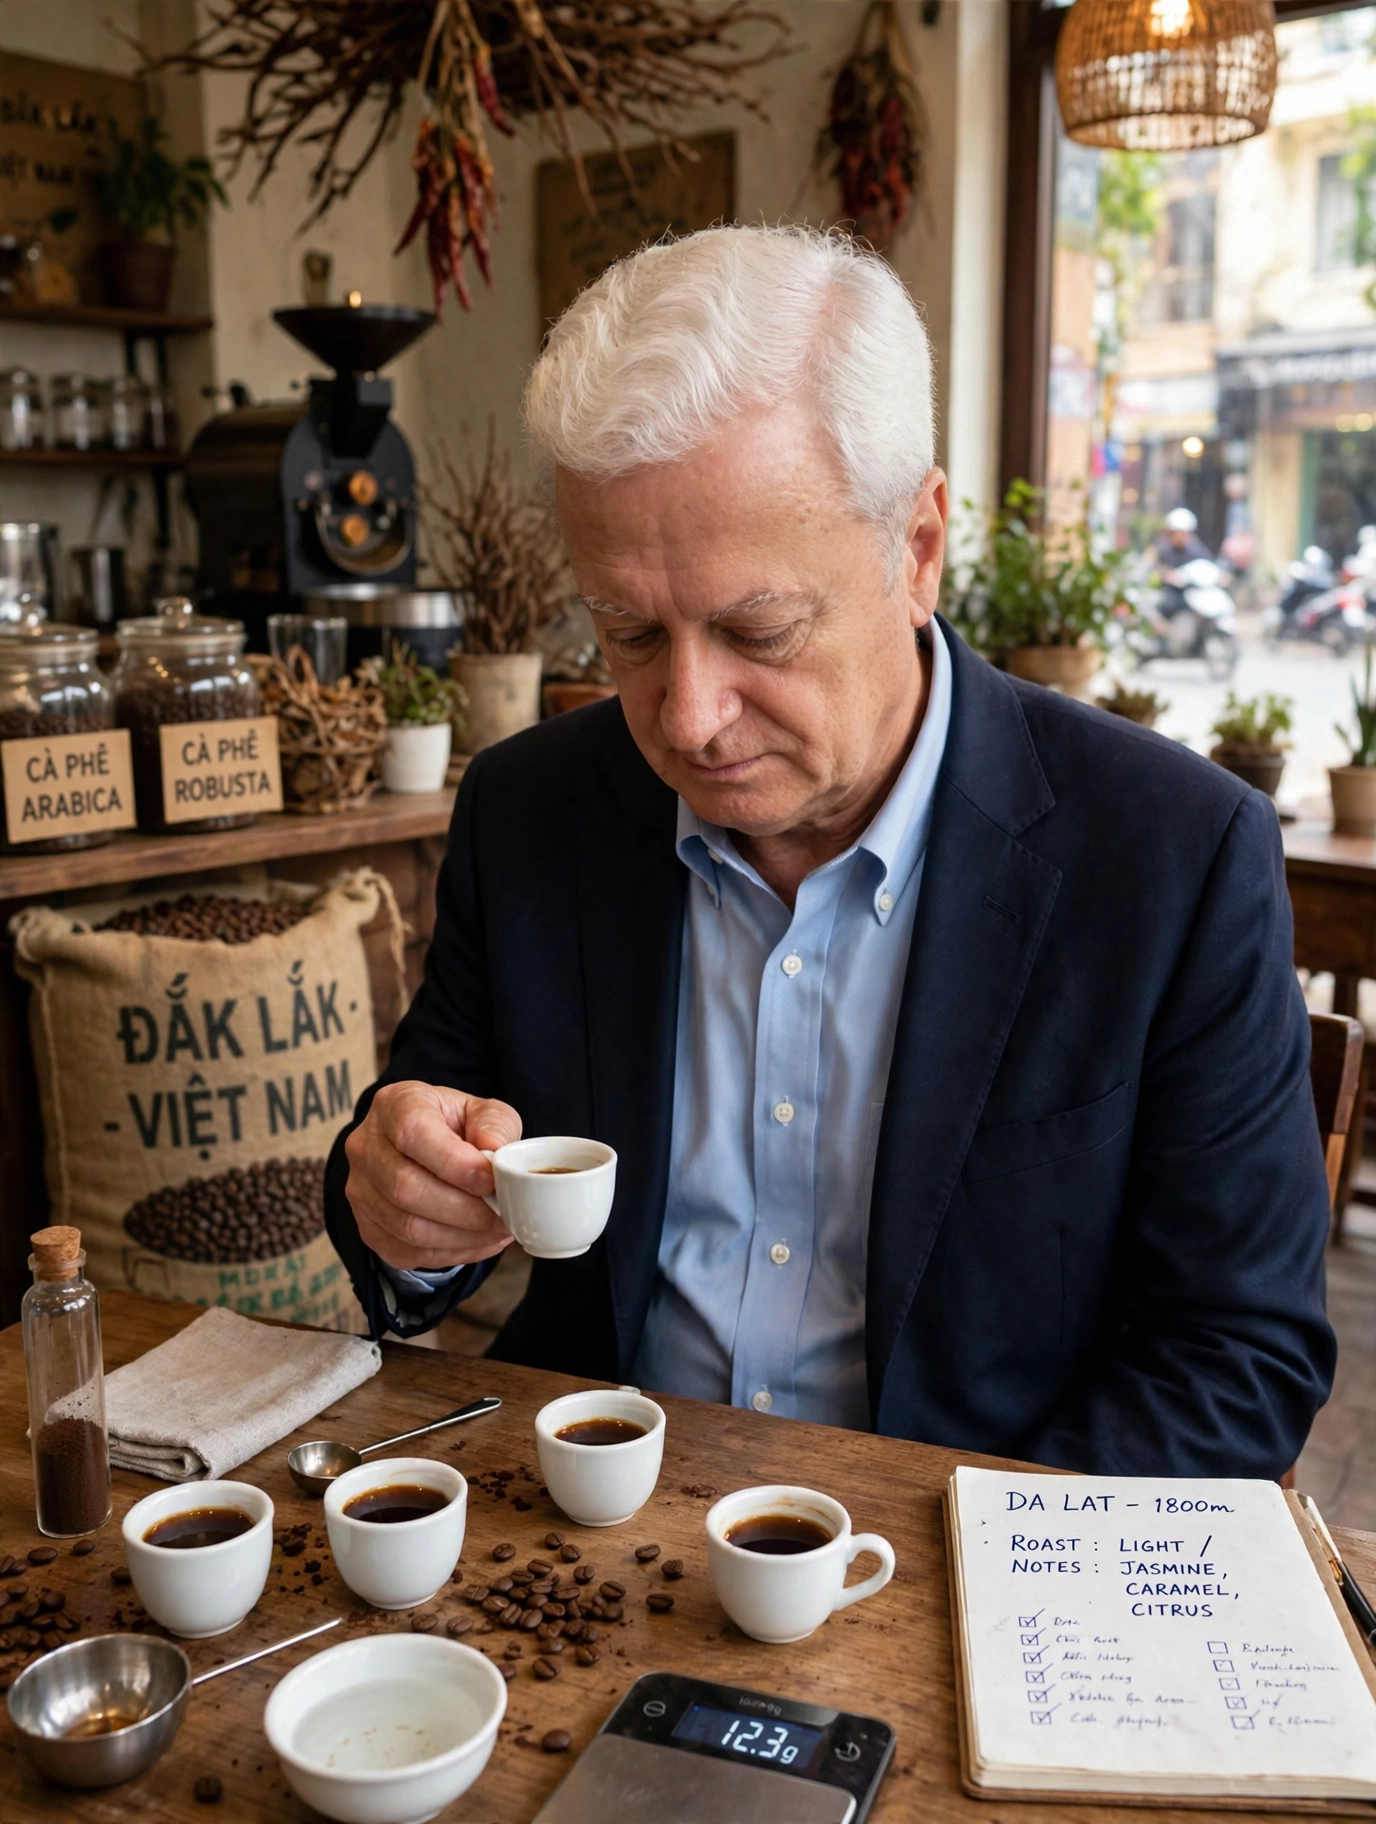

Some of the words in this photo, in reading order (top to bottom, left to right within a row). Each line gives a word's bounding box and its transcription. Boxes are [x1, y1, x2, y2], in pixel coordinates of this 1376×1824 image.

[26, 748, 58, 783] CÀ
[66, 743, 110, 778] PHÊ
[182, 735, 211, 766] CÀ
[218, 729, 259, 762] PHÊ
[175, 771, 271, 803] ROBUSTA
[21, 787, 122, 822] ARABICA
[117, 972, 244, 1065] ĐẮK
[257, 960, 344, 1053] LẮK
[265, 1060, 352, 1136] NAM
[1006, 1491, 1045, 1511] DA
[1064, 1494, 1115, 1512] LAT
[1155, 1498, 1235, 1513] 1800m
[1011, 1534, 1081, 1552] ROAST
[1119, 1538, 1185, 1552] LIGHT
[1011, 1559, 1081, 1574] NOTES
[1126, 1583, 1239, 1600] CARAMEL,
[1131, 1603, 1213, 1617] CITRUS
